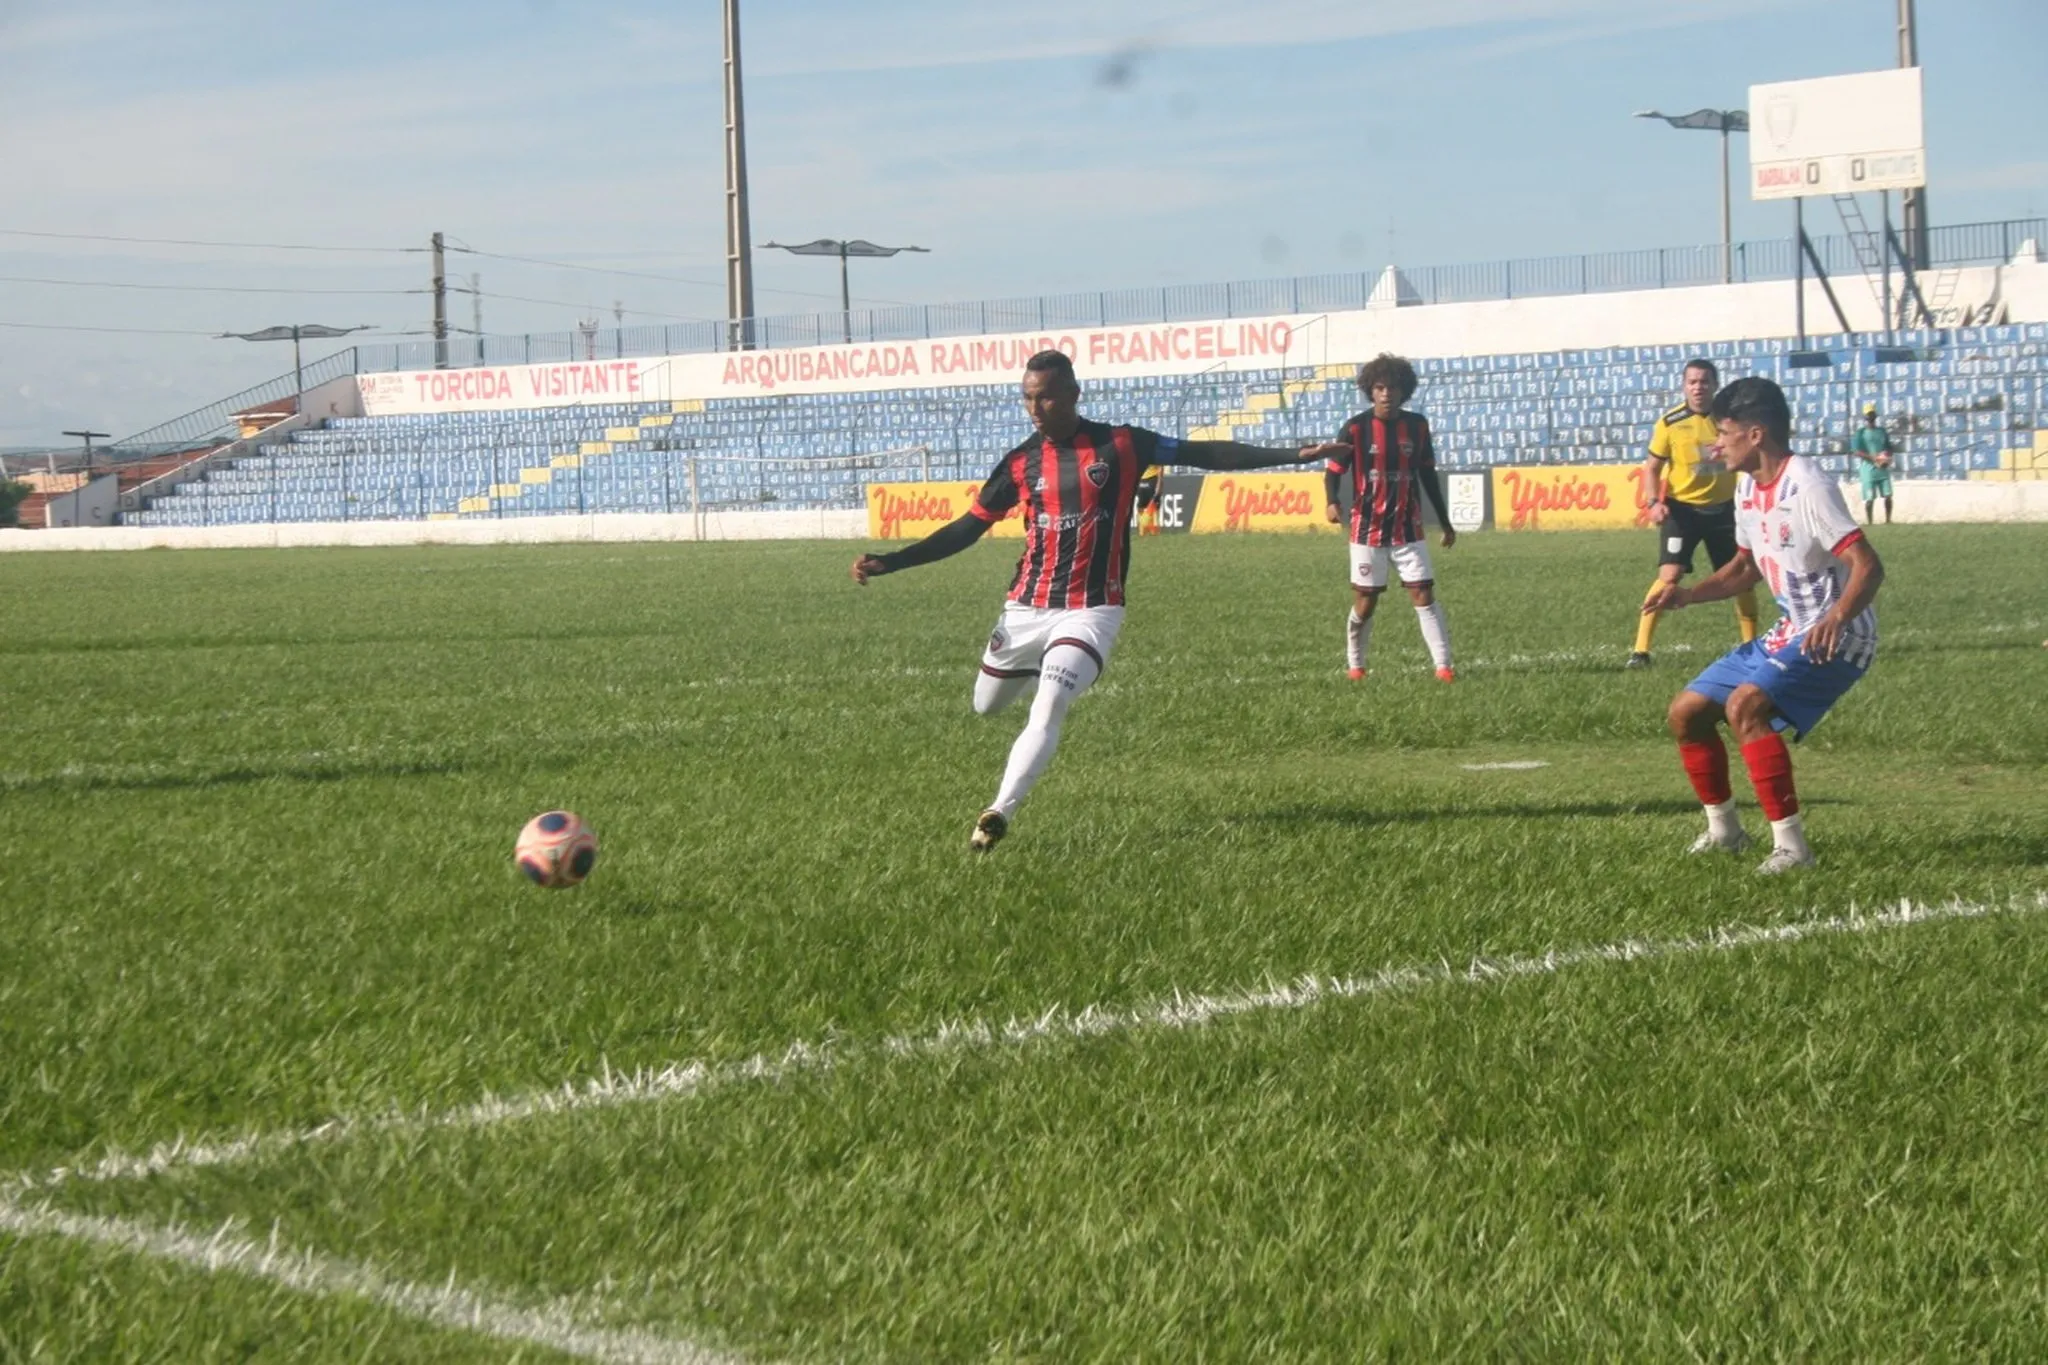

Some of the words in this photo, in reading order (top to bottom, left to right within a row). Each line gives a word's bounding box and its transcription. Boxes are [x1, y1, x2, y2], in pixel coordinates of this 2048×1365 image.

[1806, 162, 1820, 184] 0
[1851, 159, 1865, 181] 0
[722, 346, 919, 388] ARQUIBANCADA
[1089, 321, 1292, 365] FRANCELINO
[415, 369, 512, 403] TORCIDA
[529, 362, 640, 397] VISITANTE
[873, 487, 953, 539] Ypióca
[1220, 479, 1312, 532] Ypióca
[1503, 471, 1610, 530] Ypióca
